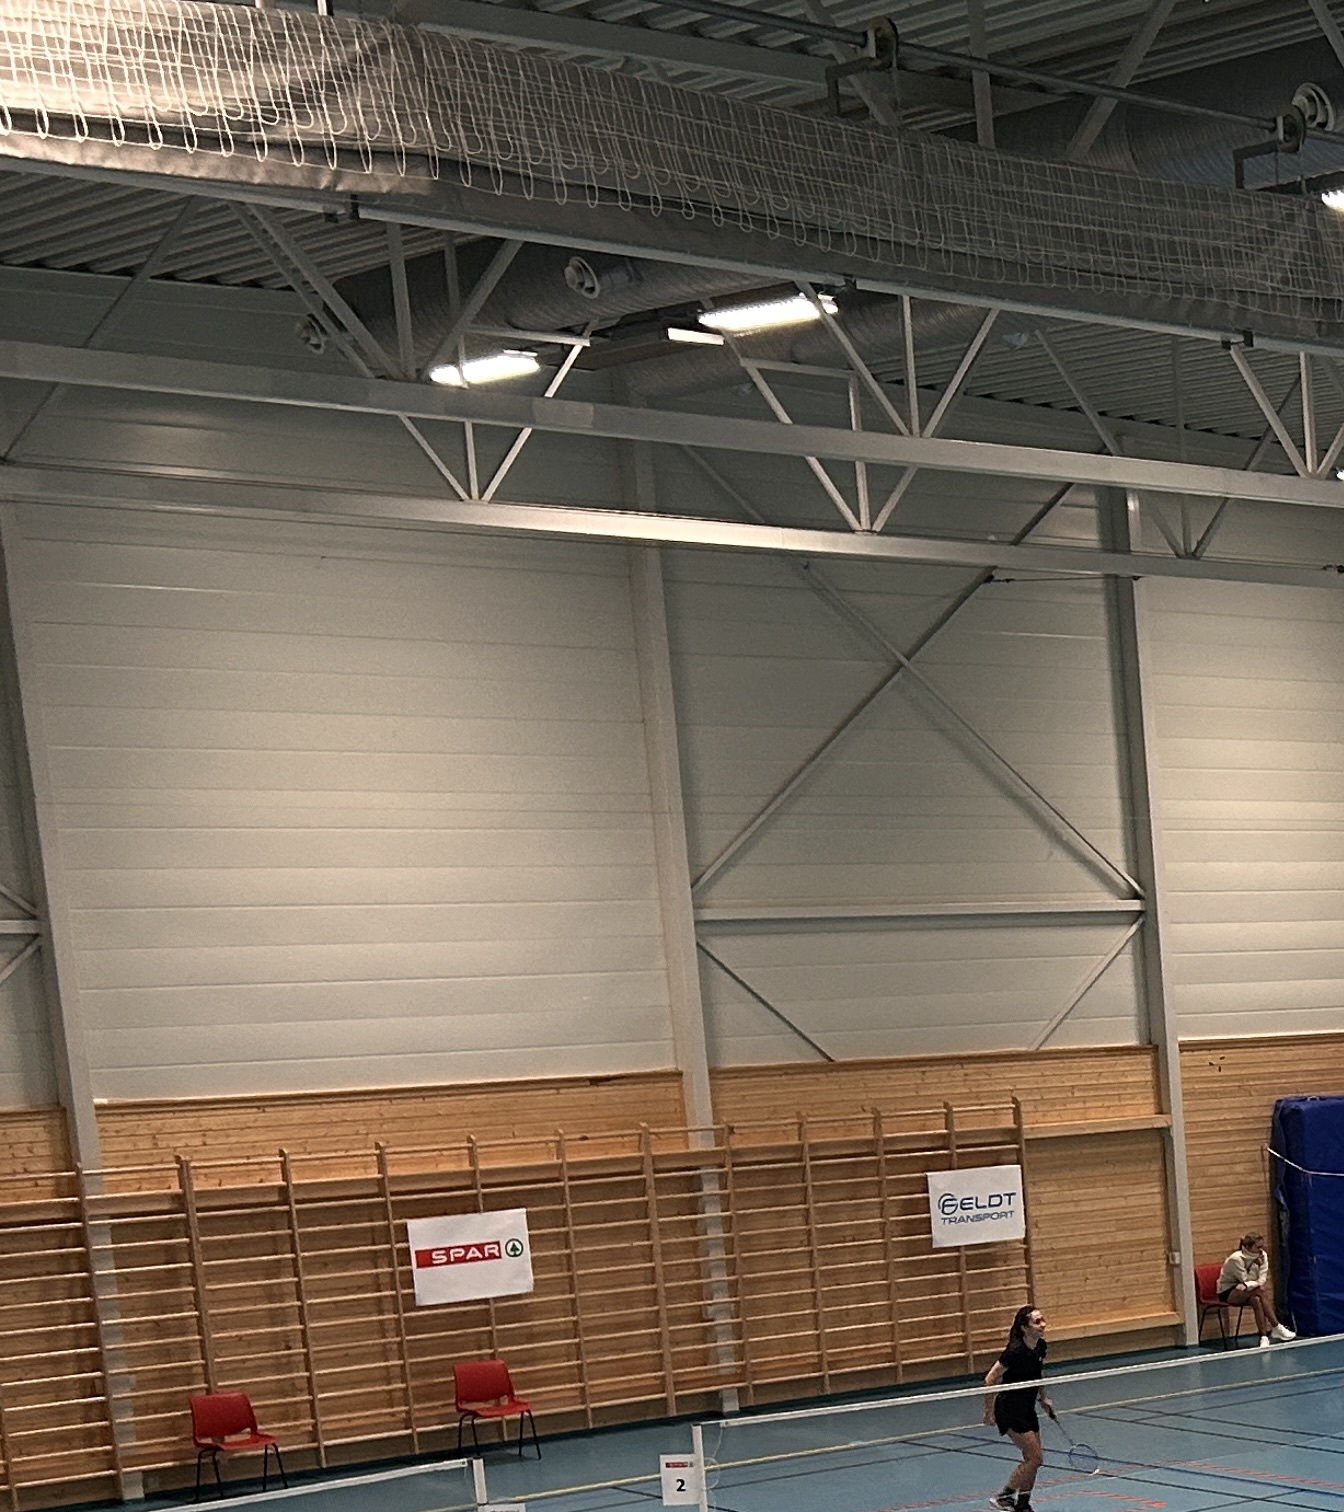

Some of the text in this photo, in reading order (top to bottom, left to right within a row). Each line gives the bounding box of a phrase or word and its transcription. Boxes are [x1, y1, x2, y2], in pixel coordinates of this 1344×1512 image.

[941, 1210, 1015, 1225] TRANSPORT
[432, 1243, 500, 1265] SPAR
[676, 1478, 687, 1492] 2
